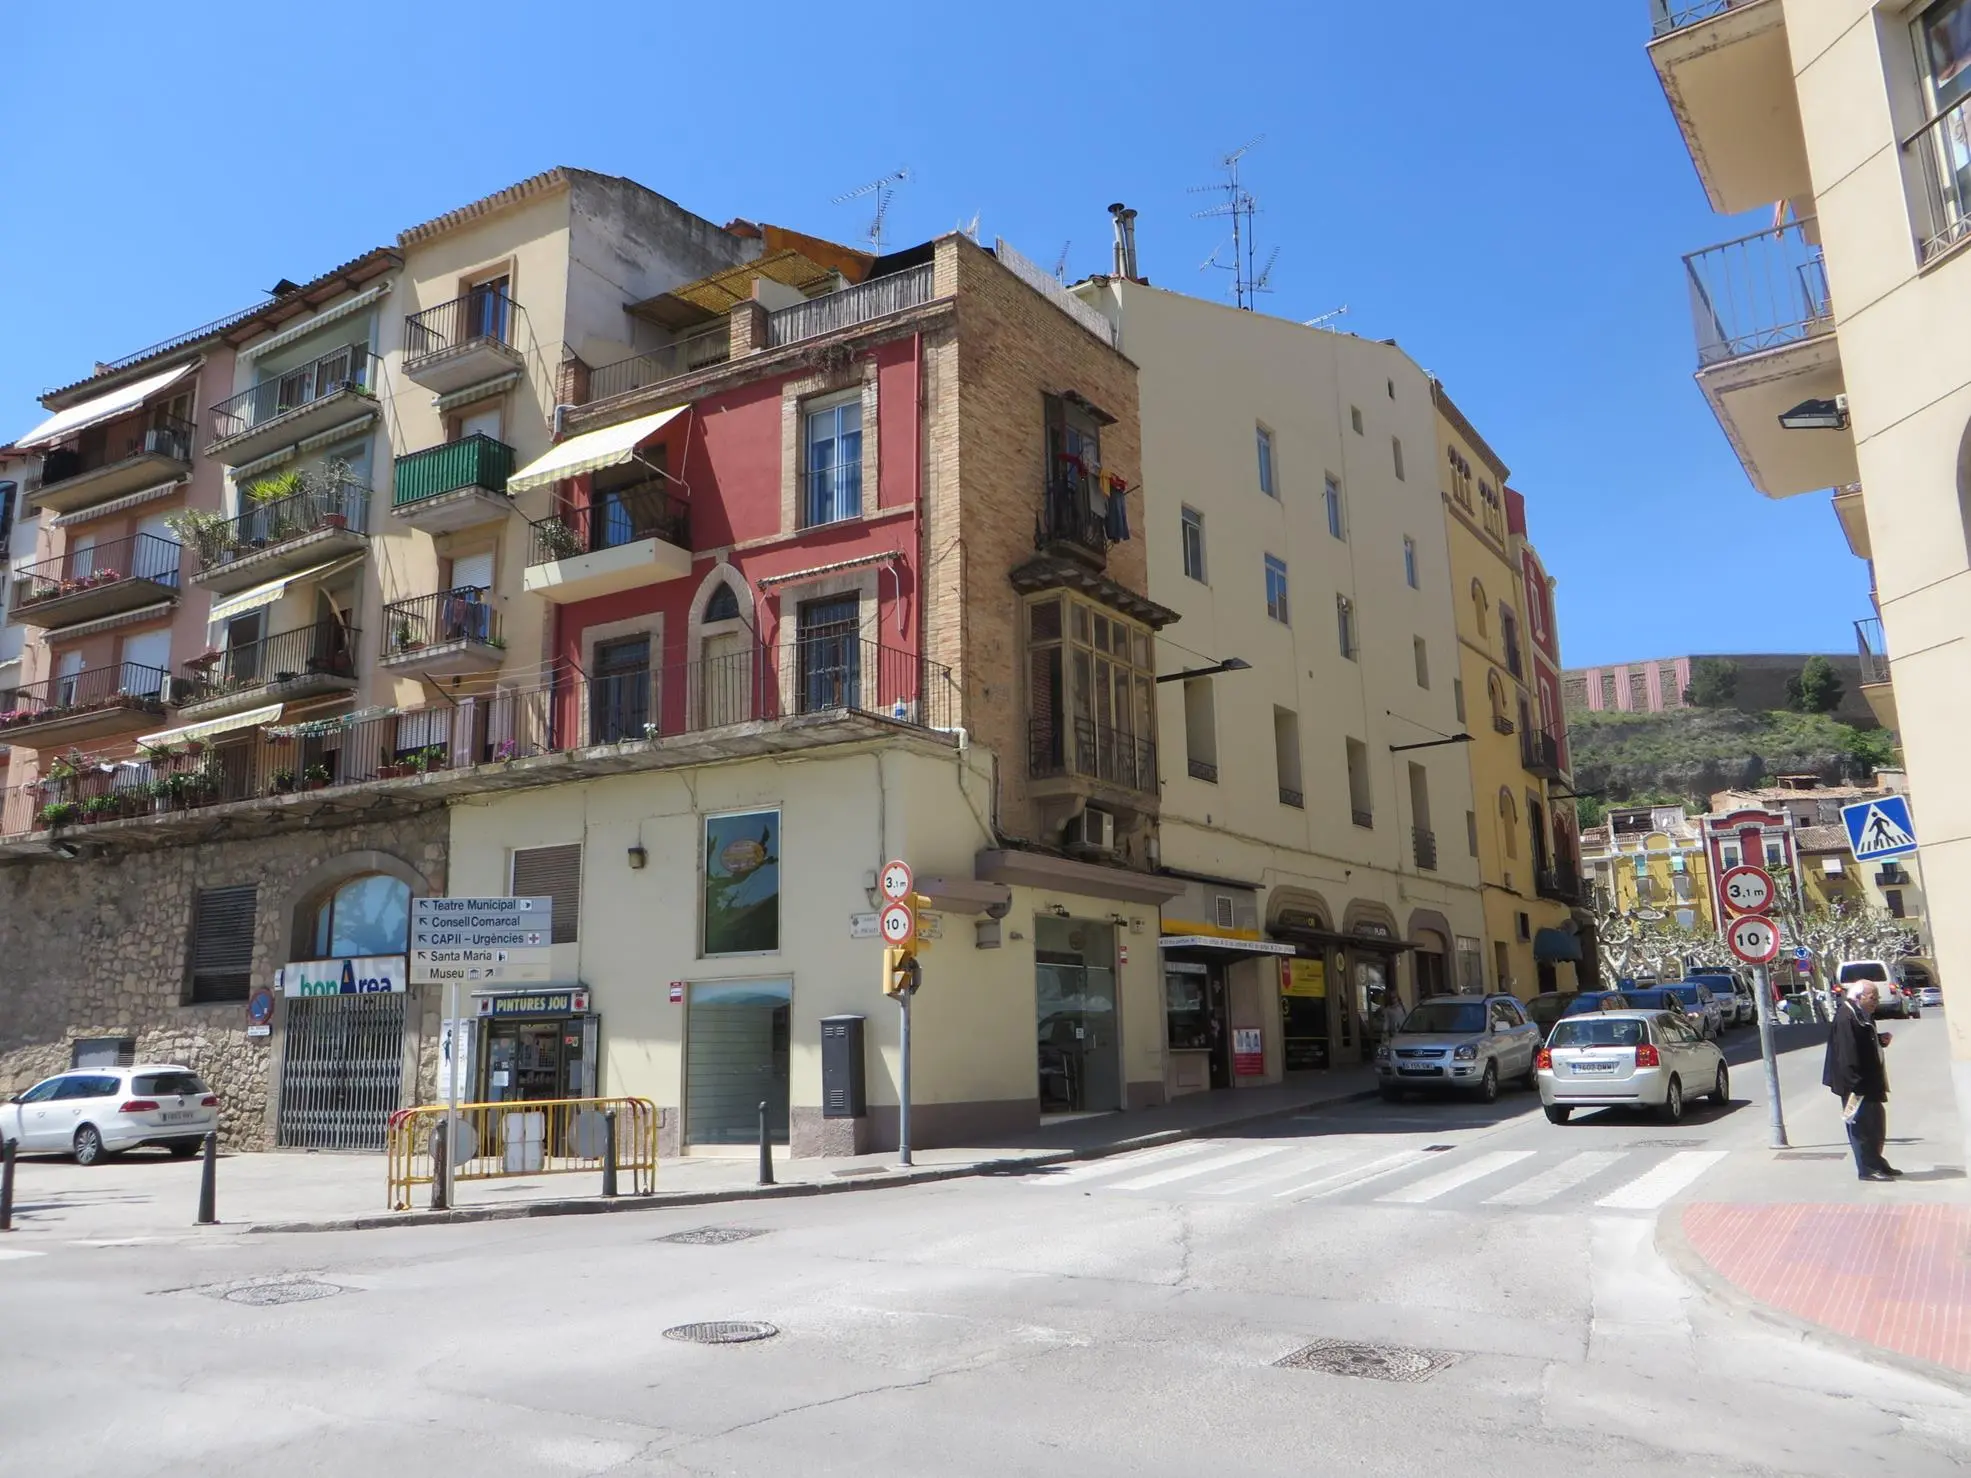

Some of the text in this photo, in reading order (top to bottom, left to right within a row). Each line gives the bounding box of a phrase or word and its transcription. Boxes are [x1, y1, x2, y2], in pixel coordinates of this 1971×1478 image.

[432, 899, 516, 912] Teatre Municipal
[432, 915, 521, 928] Consell Comarcal
[886, 918, 899, 930] 10
[472, 932, 524, 946] Urgències
[1736, 932, 1760, 946] 10
[430, 950, 492, 962] Santa Maria
[300, 959, 392, 996] bonArea
[430, 968, 464, 979] Museu
[496, 996, 568, 1012] PINTURES JOU
